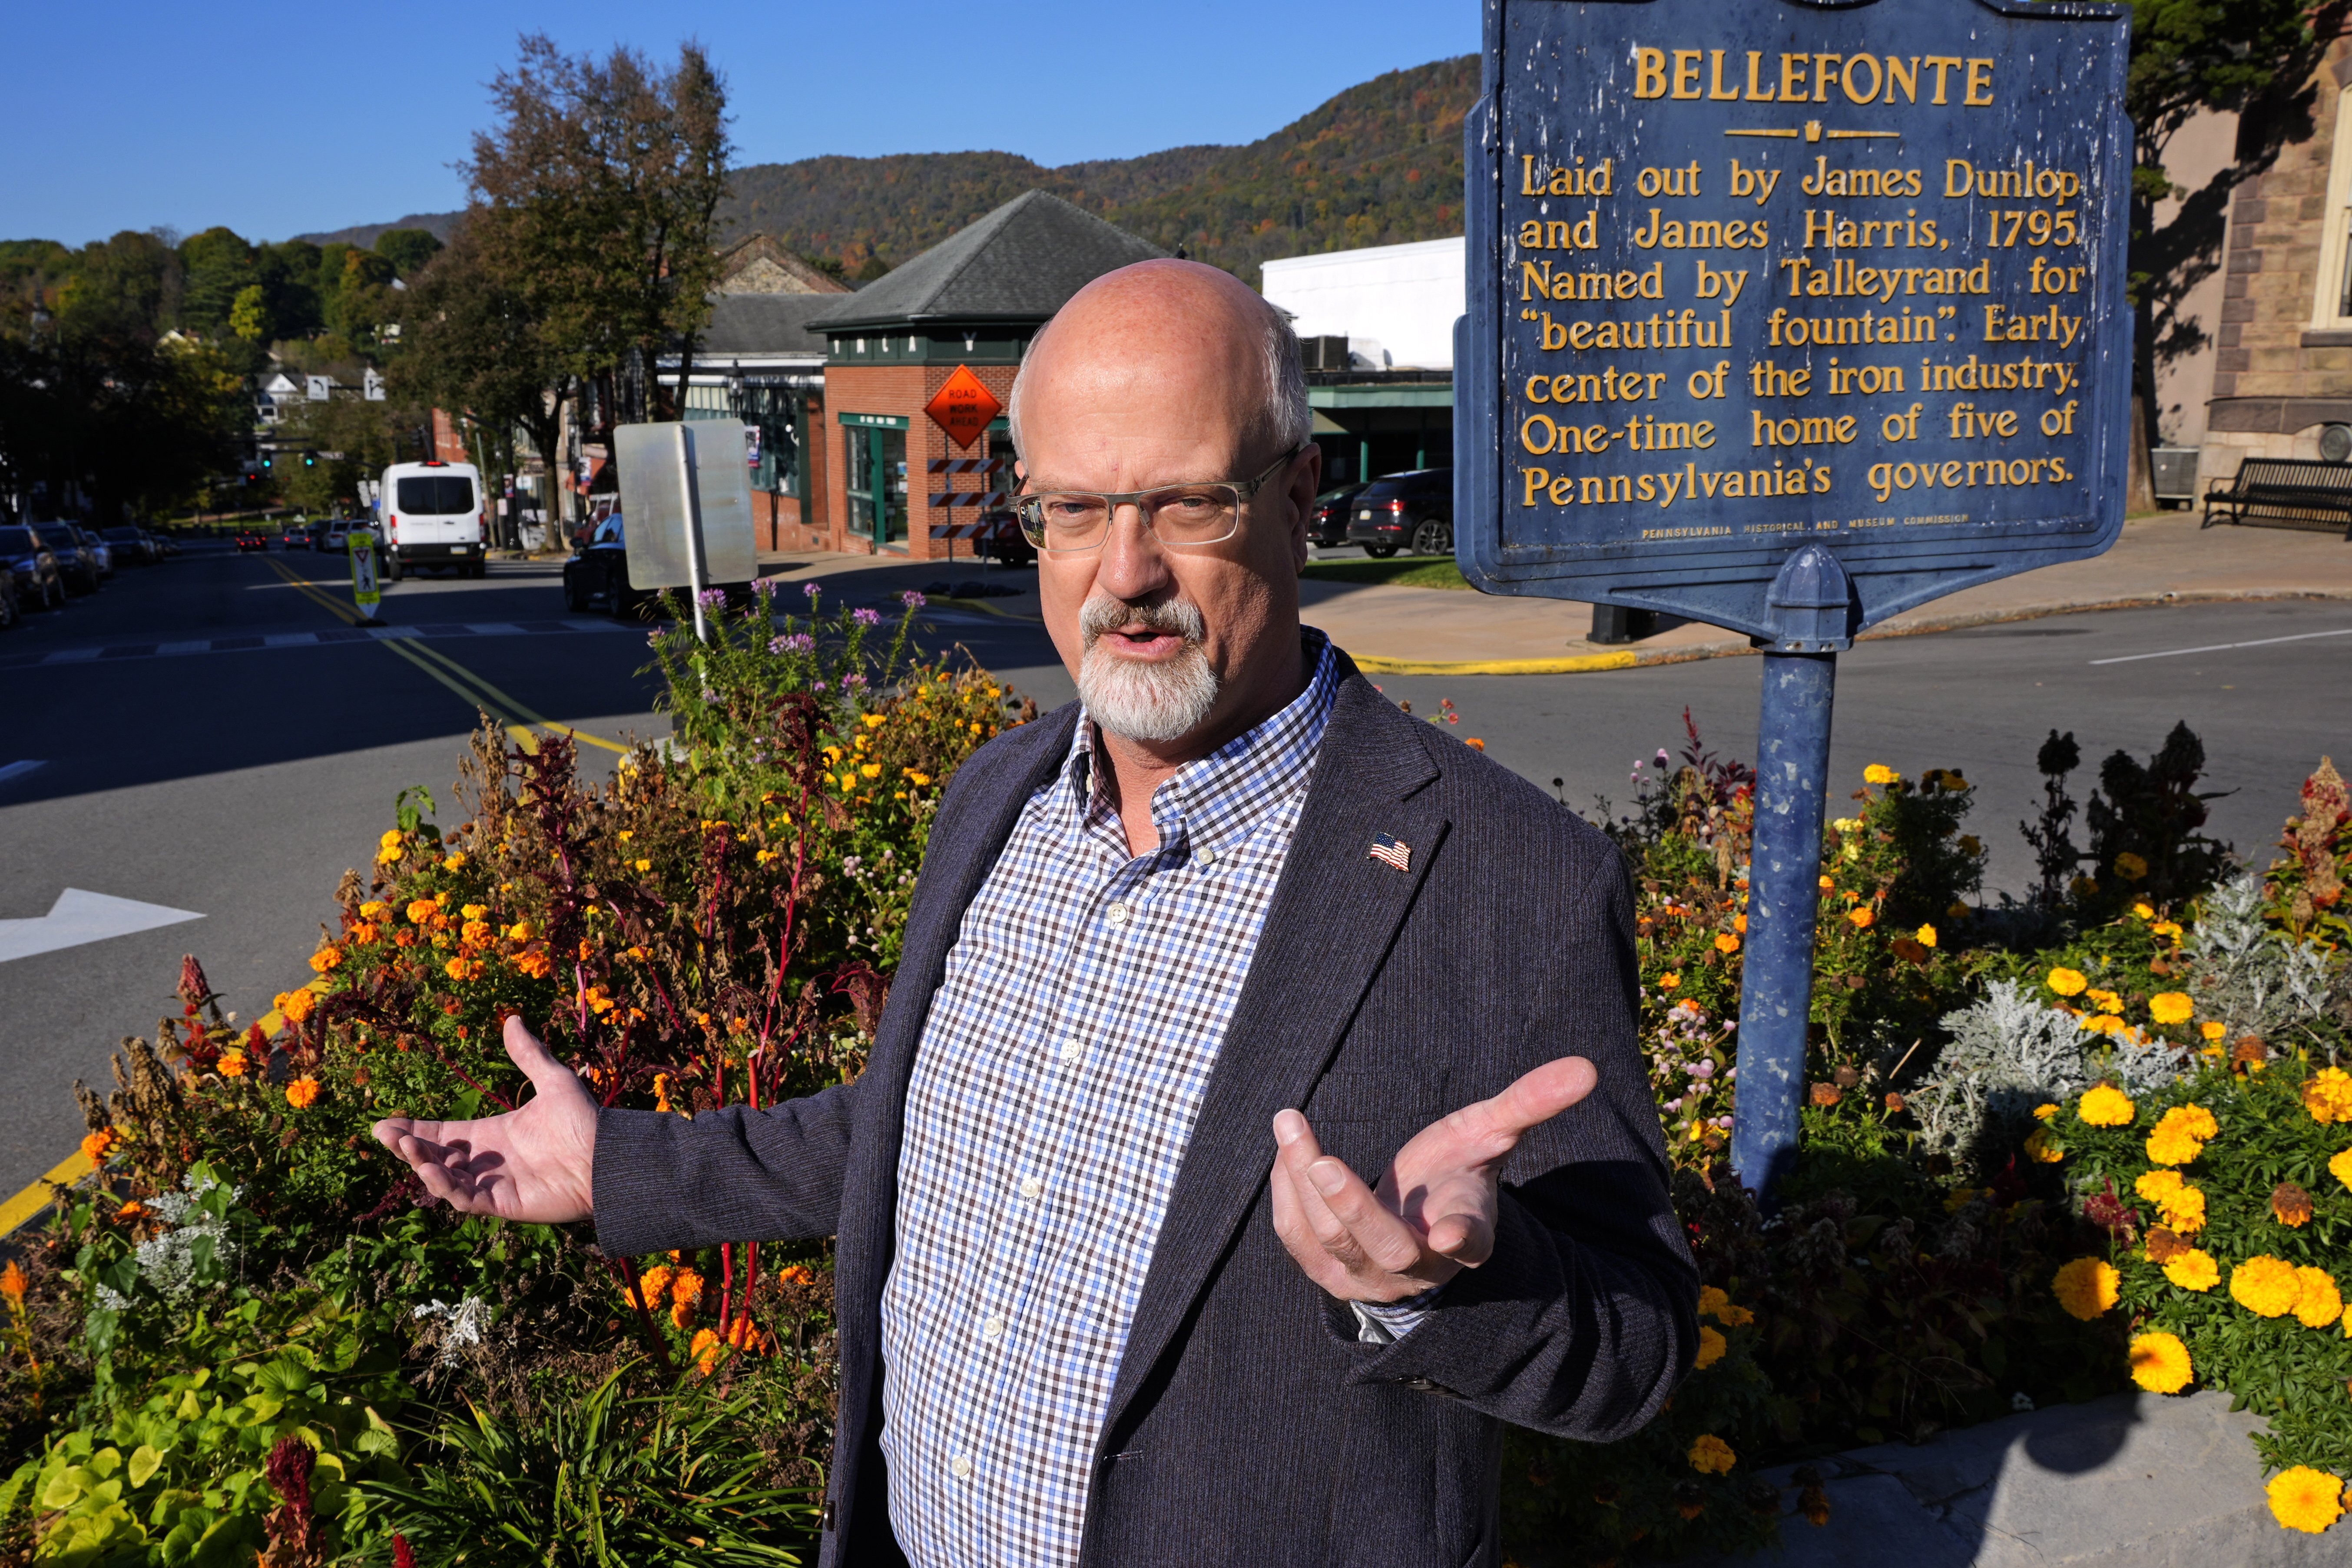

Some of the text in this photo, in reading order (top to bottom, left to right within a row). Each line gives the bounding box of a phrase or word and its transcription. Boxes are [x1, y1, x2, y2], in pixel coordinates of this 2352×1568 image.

[1634, 48, 1994, 105] BELLEFONTE
[1523, 155, 2080, 205] Laid out by James Dunlop
[1521, 211, 1599, 249] and
[1636, 209, 1768, 248] James
[1807, 210, 1948, 250] Harris,
[1522, 257, 2085, 306] Named by Talleyrand for
[1985, 305, 2081, 347] Early
[949, 389, 977, 399] ROAD
[1526, 356, 2078, 403] center of the iron industry.
[949, 404, 977, 413] WORK
[950, 417, 979, 427] AHEAD
[1522, 401, 2077, 454] One-time home of five of
[1523, 458, 2073, 507] Pennsylvania's governors.
[1642, 514, 1969, 539] PENNSYLVANIA HISTORICAL AND MUSEUM COMMISSION
